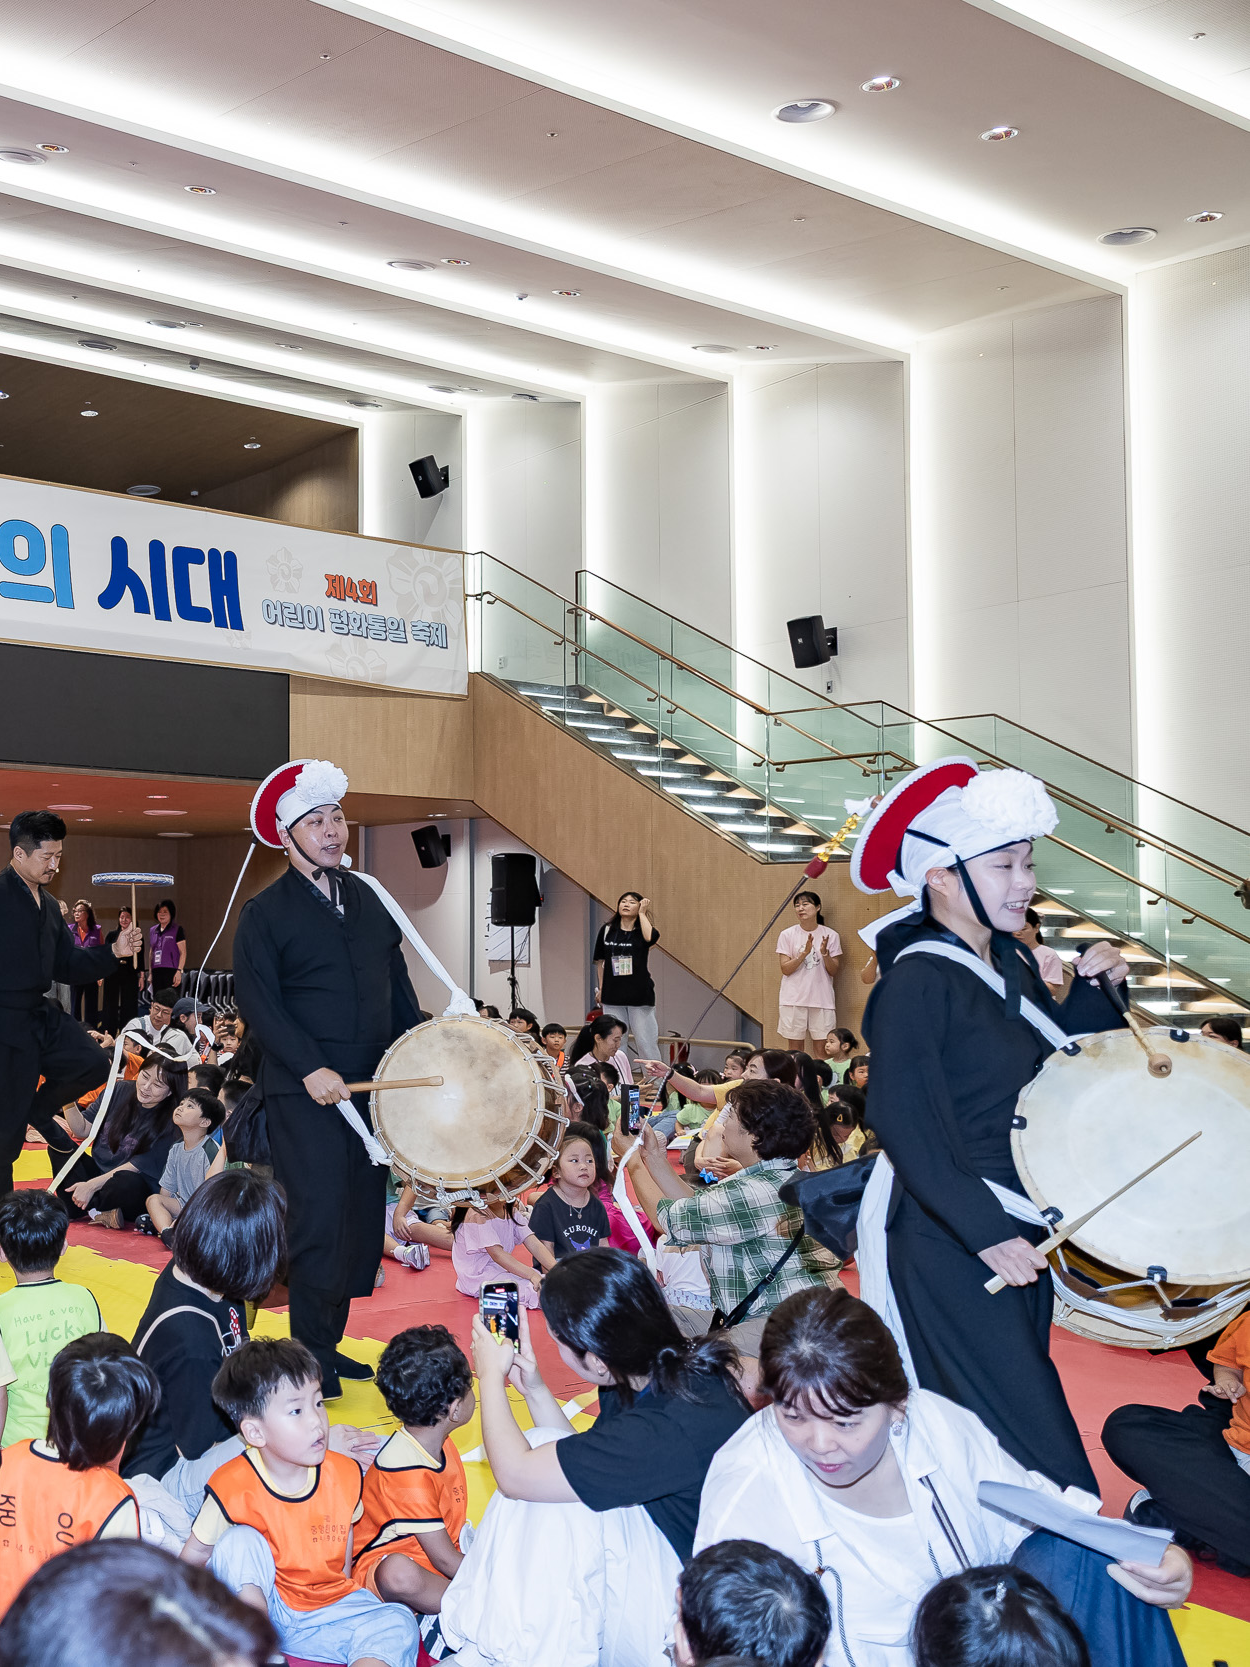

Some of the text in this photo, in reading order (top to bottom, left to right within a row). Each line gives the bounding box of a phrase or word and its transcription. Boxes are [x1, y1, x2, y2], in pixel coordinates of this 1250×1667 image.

[96, 535, 244, 632] 시대
[324, 573, 378, 606] 제4회
[261, 598, 448, 649] 어린이 평화통일 축제
[563, 1225, 598, 1237] KUROMI
[14, 1313, 42, 1327] Have
[60, 1306, 85, 1317] very
